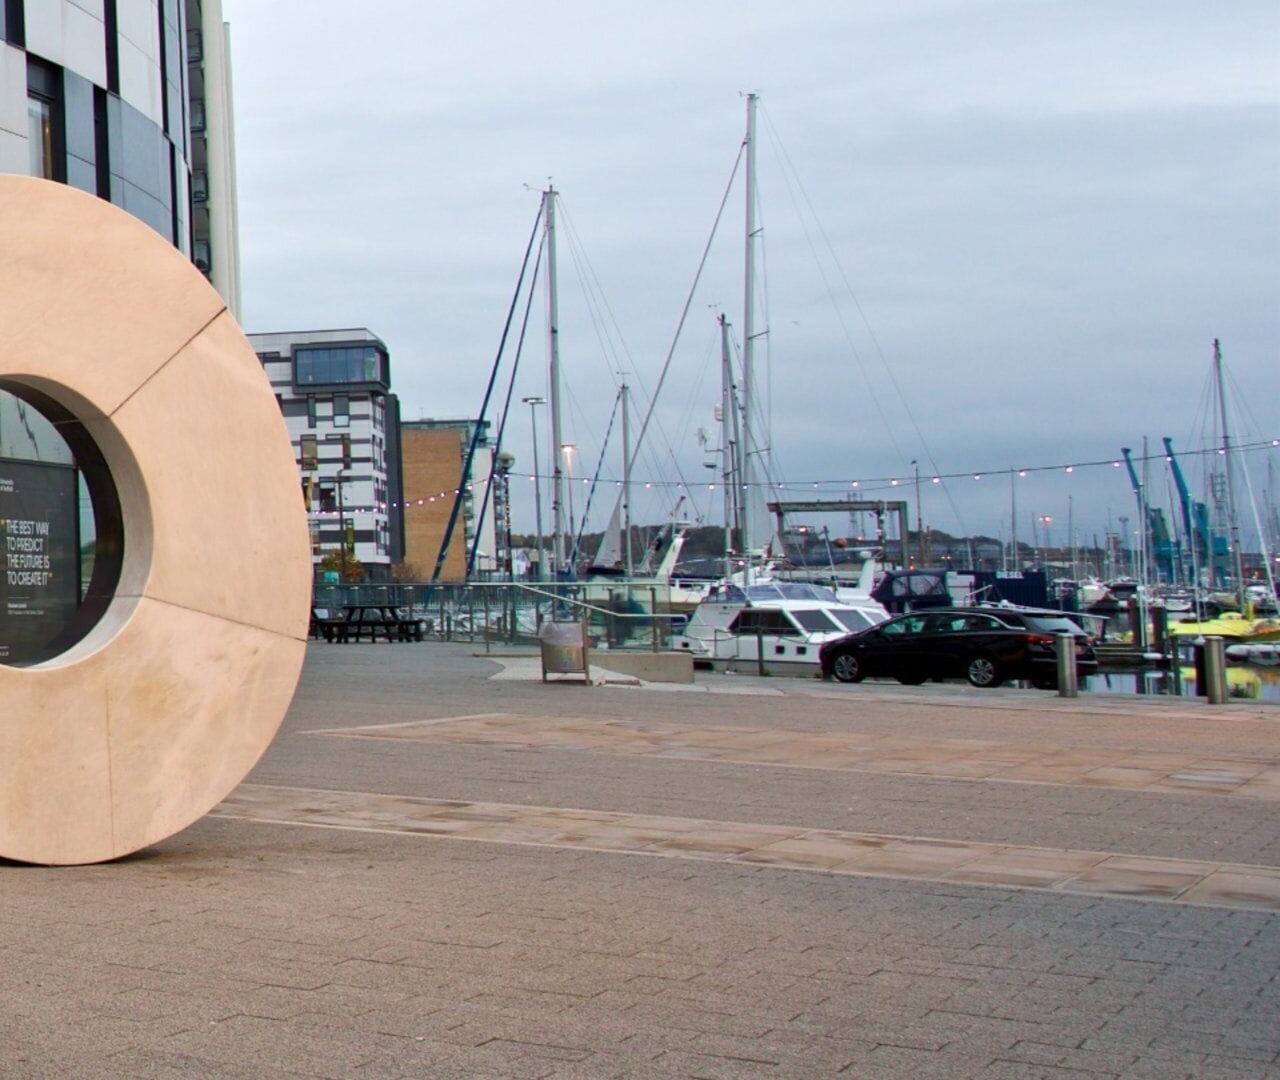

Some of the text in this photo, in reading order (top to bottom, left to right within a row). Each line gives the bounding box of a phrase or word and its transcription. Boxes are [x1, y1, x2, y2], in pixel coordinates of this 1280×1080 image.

[6, 520, 50, 536] THE BEST WAY
[6, 537, 44, 552] TO PREDICT
[6, 554, 50, 569] THE FUTURE IS
[7, 571, 17, 585] TO
[17, 572, 41, 586] CREATE
